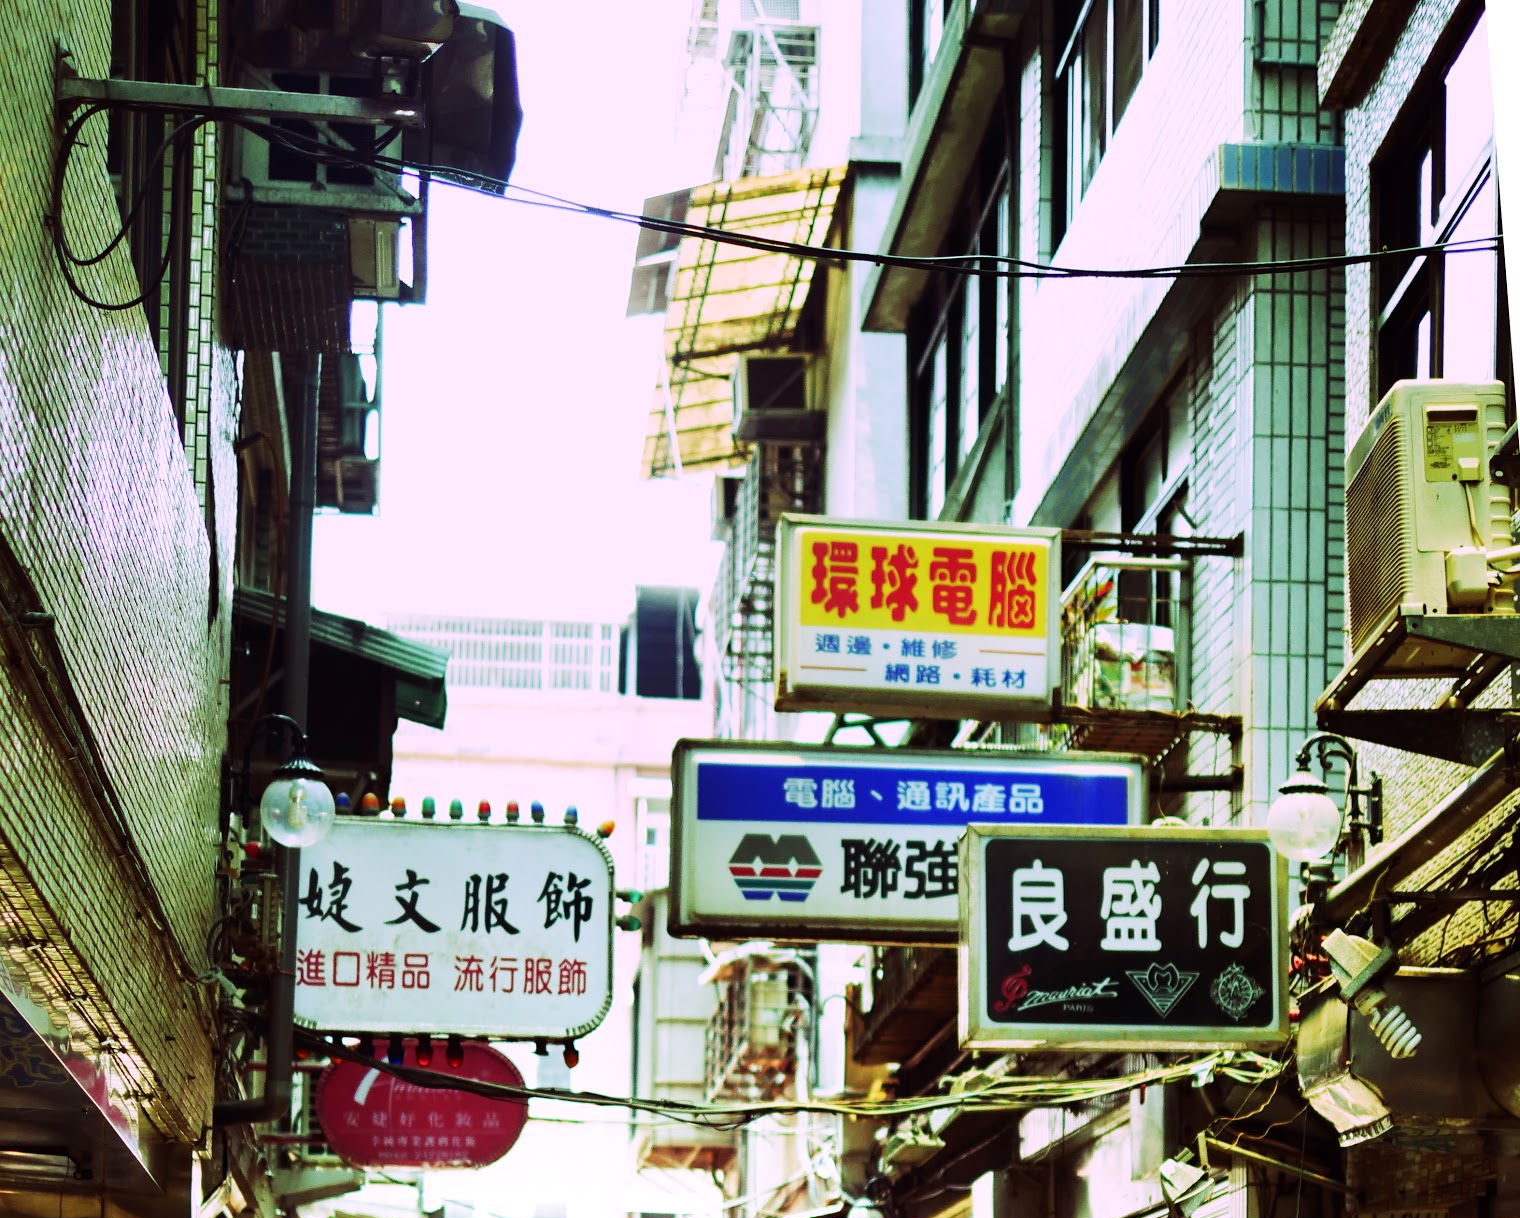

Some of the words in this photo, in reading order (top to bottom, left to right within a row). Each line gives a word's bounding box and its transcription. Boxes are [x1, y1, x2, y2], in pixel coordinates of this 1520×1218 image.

[811, 540, 1038, 631] 環球電腦
[783, 776, 1045, 815] 電腦、通訊產品
[299, 861, 594, 943] 婕文服飾
[1007, 857, 1252, 952] 良盛行
[296, 949, 431, 990] 進口精品
[453, 954, 588, 996] 流行服飾
